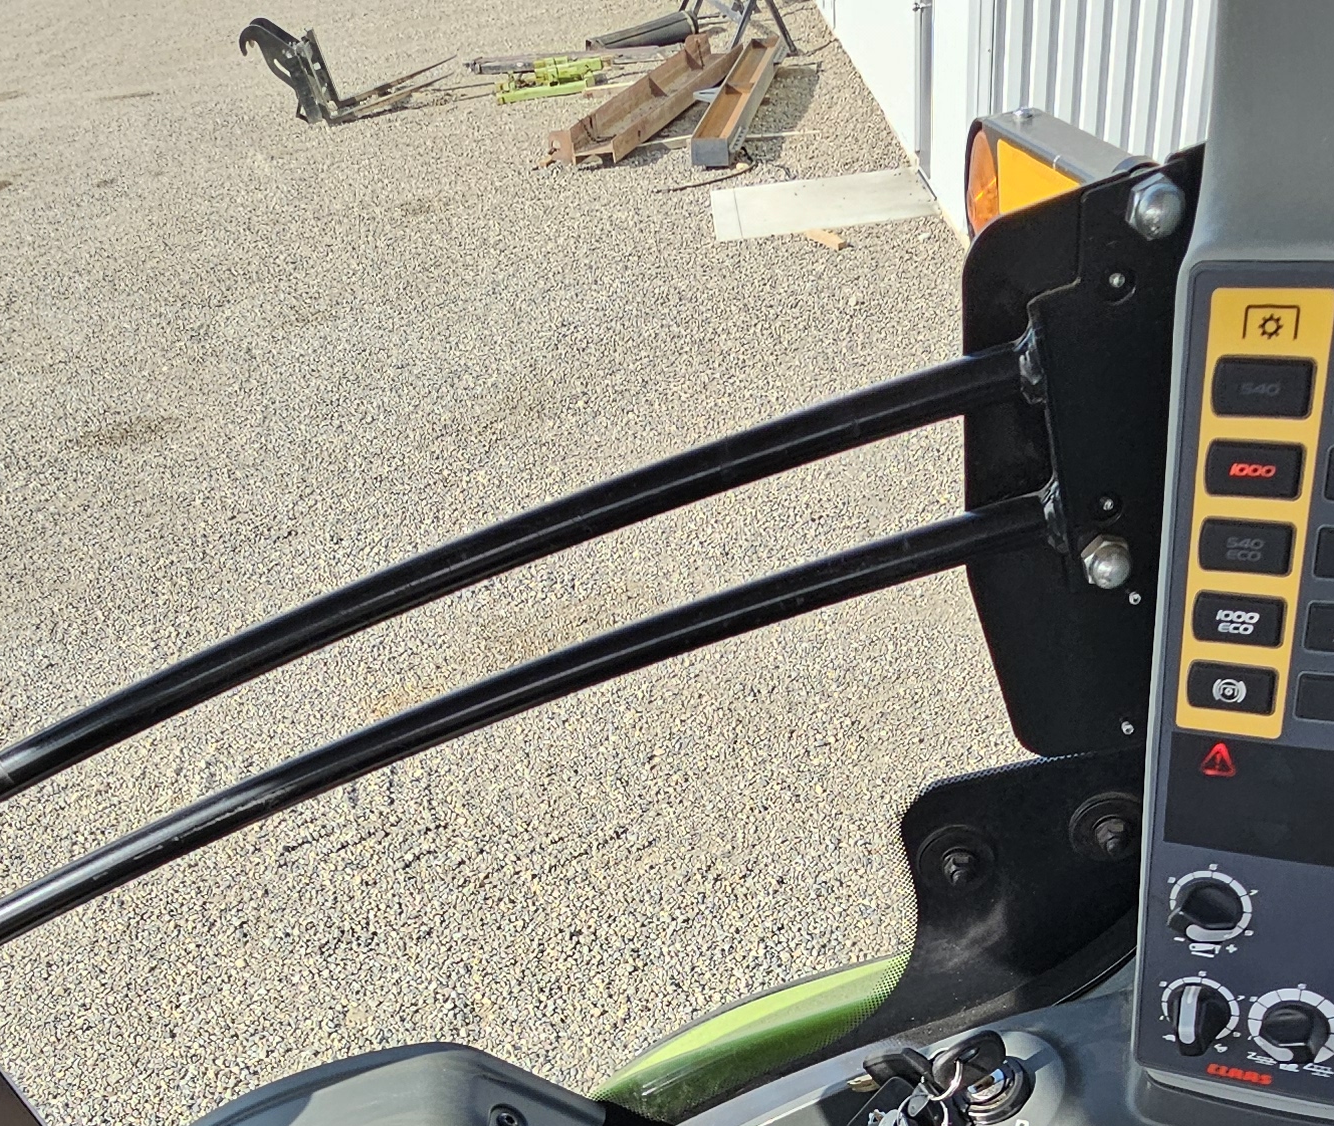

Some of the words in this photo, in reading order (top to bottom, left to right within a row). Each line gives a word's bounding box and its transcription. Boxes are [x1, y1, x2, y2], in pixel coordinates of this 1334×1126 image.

[1229, 462, 1276, 478] 1000
[1226, 536, 1266, 550] 540
[1215, 609, 1260, 624] 1000
[1218, 622, 1254, 635] ECO
[1206, 1063, 1273, 1086] CLAAS
